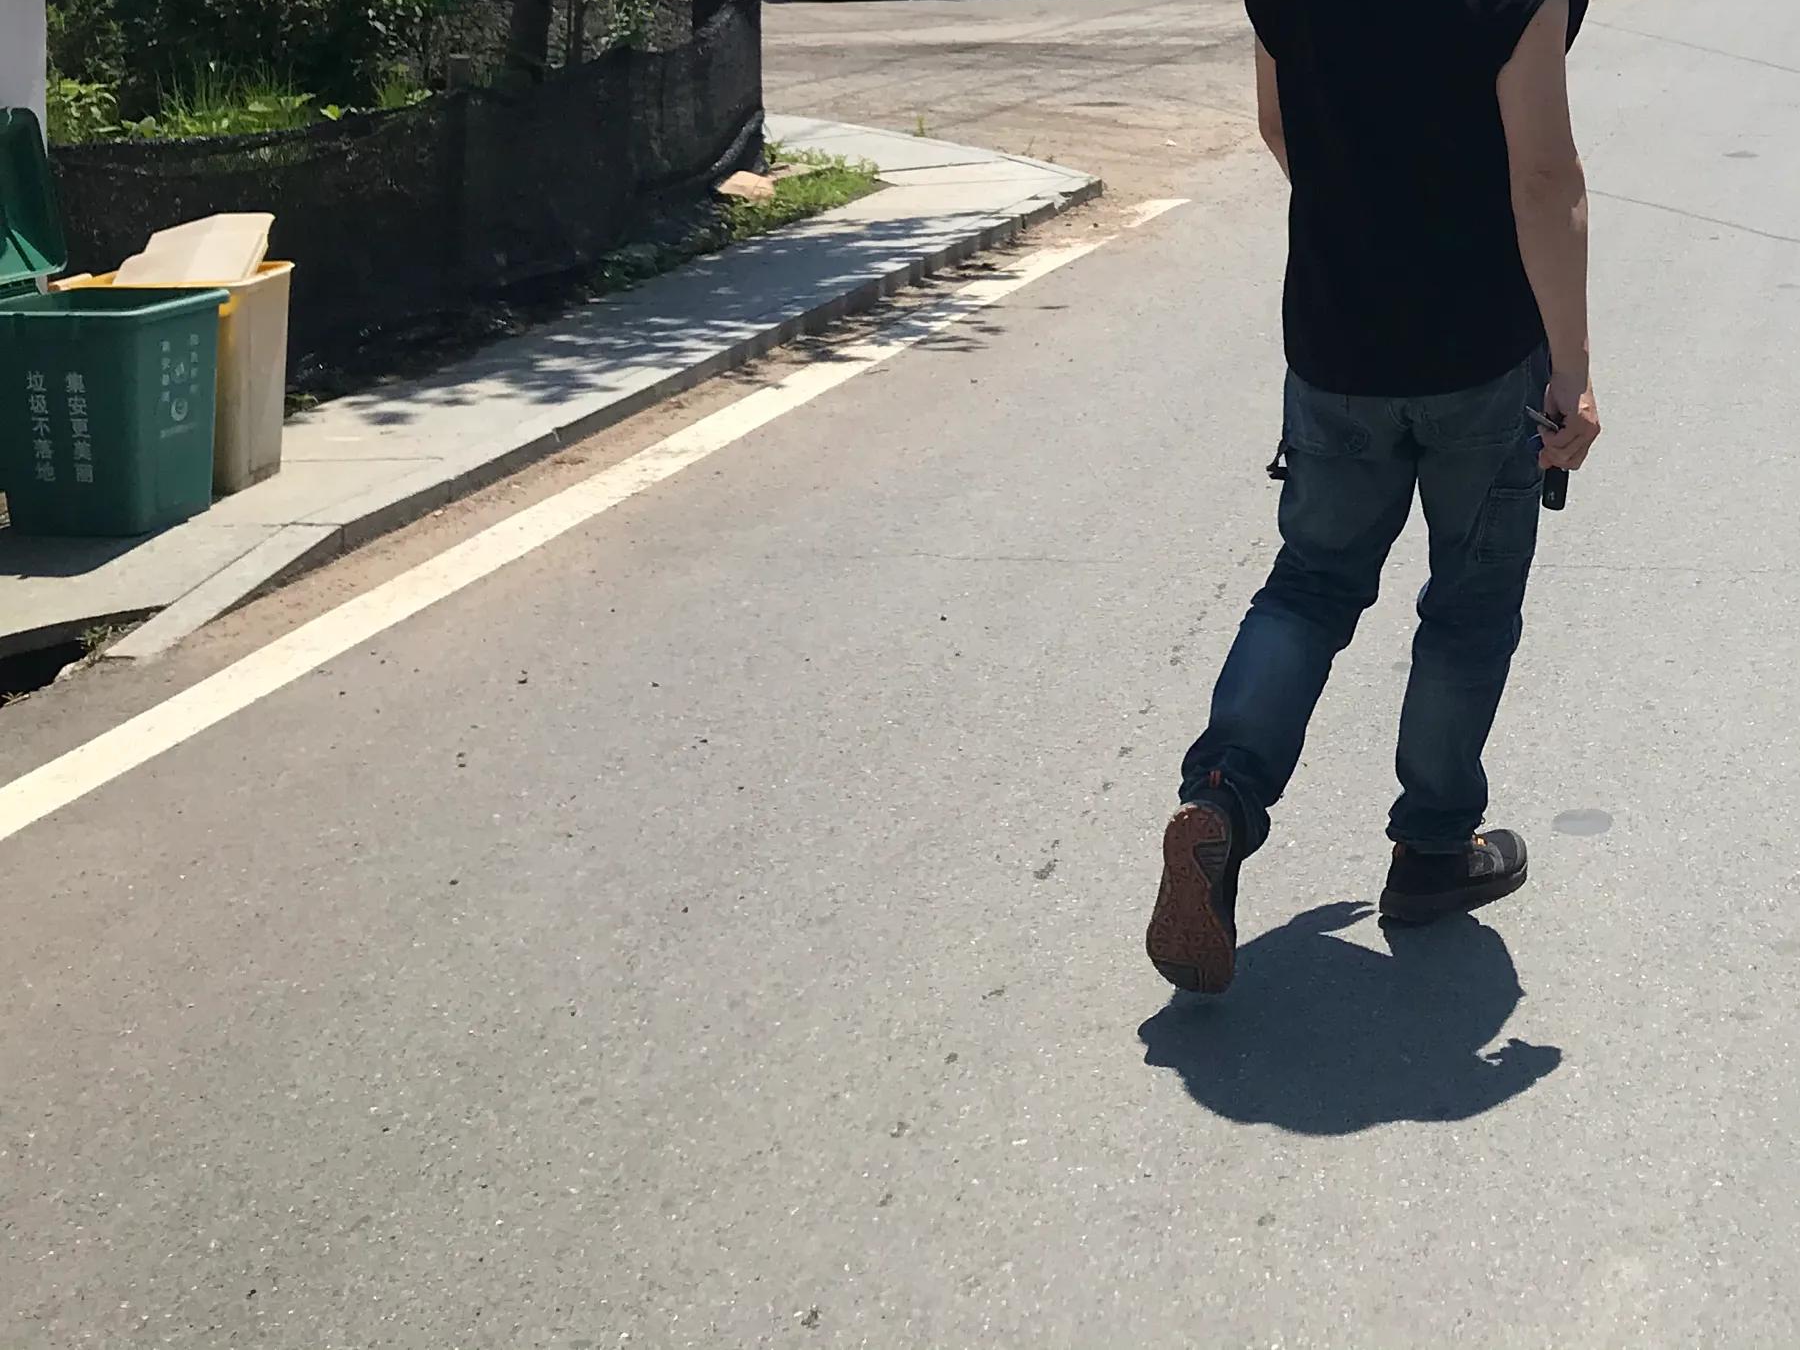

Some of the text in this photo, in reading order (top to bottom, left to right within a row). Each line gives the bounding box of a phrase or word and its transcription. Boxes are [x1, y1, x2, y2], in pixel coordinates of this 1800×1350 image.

[26, 370, 56, 482] 垃圾不落地
[65, 371, 94, 483] 集安更美丽
